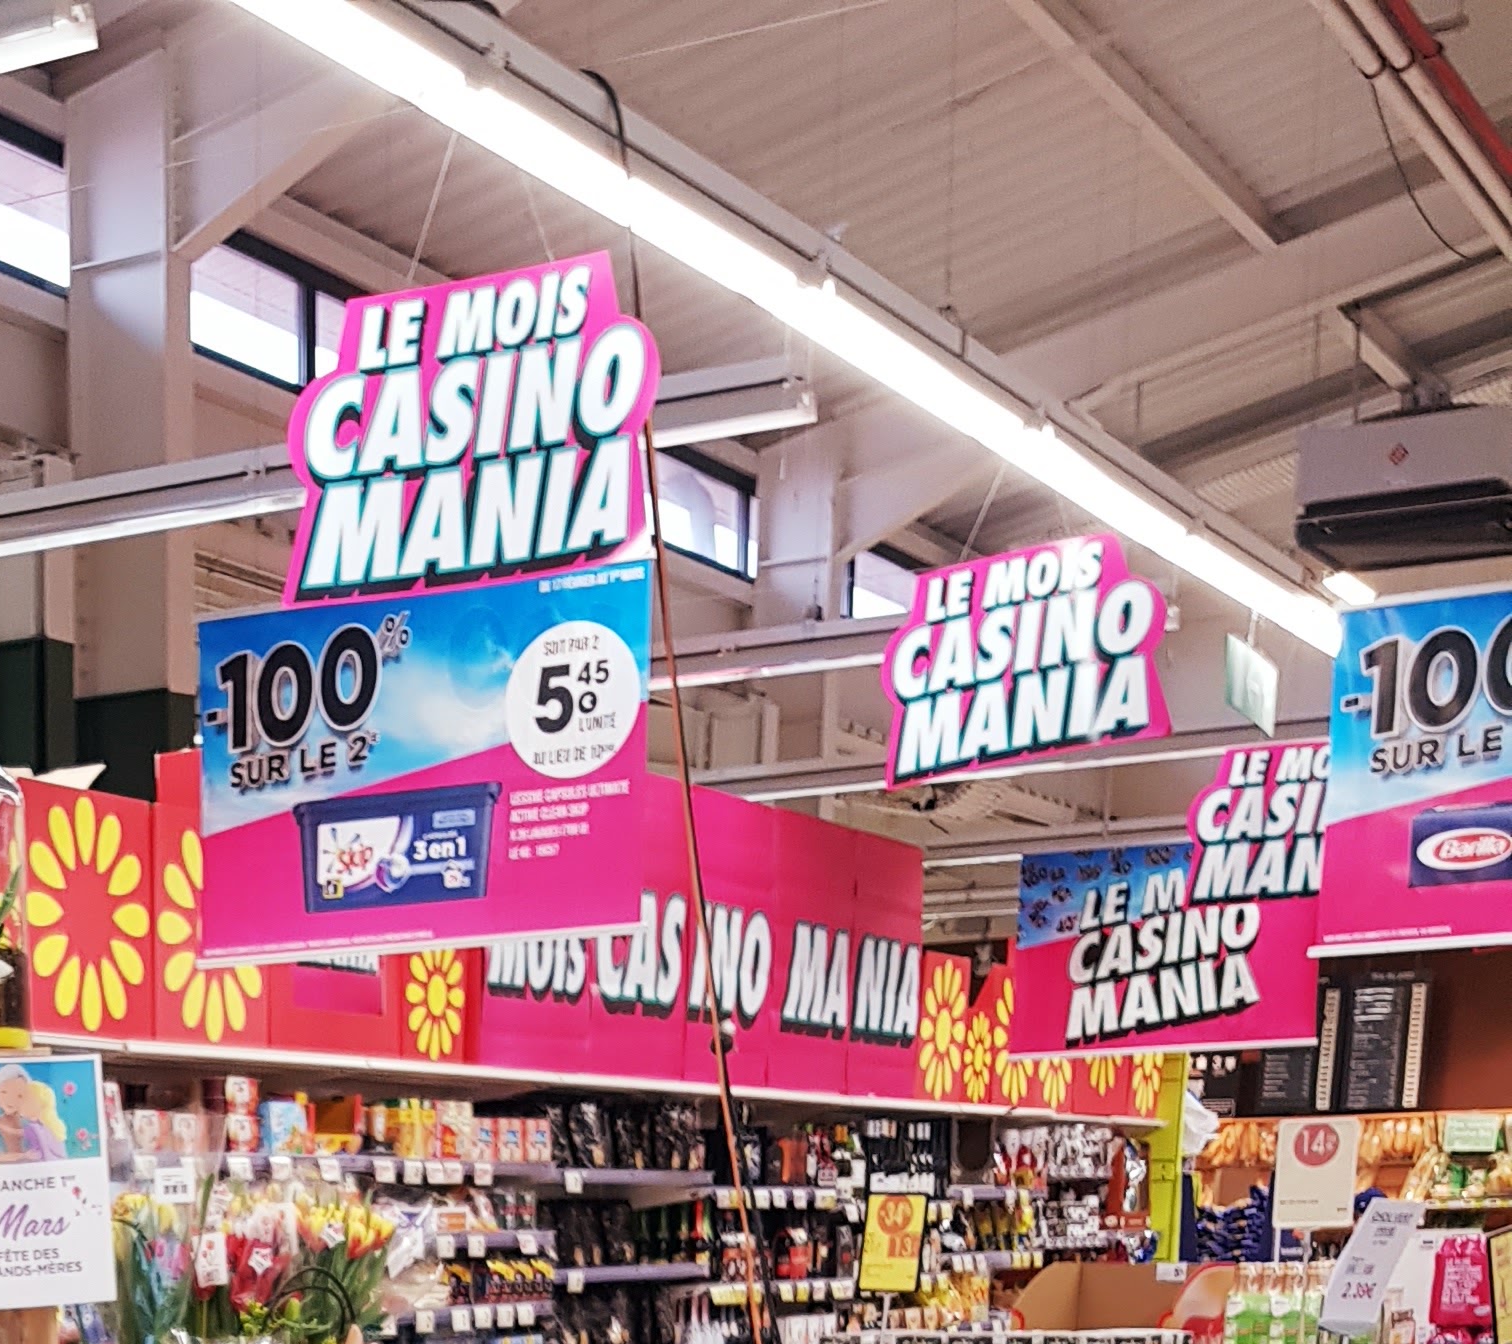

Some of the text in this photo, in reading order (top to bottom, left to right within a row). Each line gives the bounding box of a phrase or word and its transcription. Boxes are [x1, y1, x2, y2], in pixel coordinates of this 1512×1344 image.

[358, 264, 592, 371] LE MOIS
[305, 323, 646, 479] CASINO
[301, 435, 632, 590] MANIA
[926, 540, 1106, 624] LE MOIS
[892, 582, 1155, 701] CASINO
[894, 655, 1149, 780] MANIA
[1368, 722, 1505, 777] SUR LE
[230, 740, 337, 792] SUR LE
[1227, 745, 1331, 788] LE MO
[413, 839, 428, 861] 3
[428, 840, 456, 860] en
[455, 835, 468, 857] 1
[1196, 779, 1329, 846] CASI
[1191, 836, 1325, 900] MAN
[1079, 881, 1129, 931] LE
[1068, 902, 1260, 988] CASINO
[1067, 946, 1260, 1041] MANIA
[33, 1247, 60, 1261] DES
